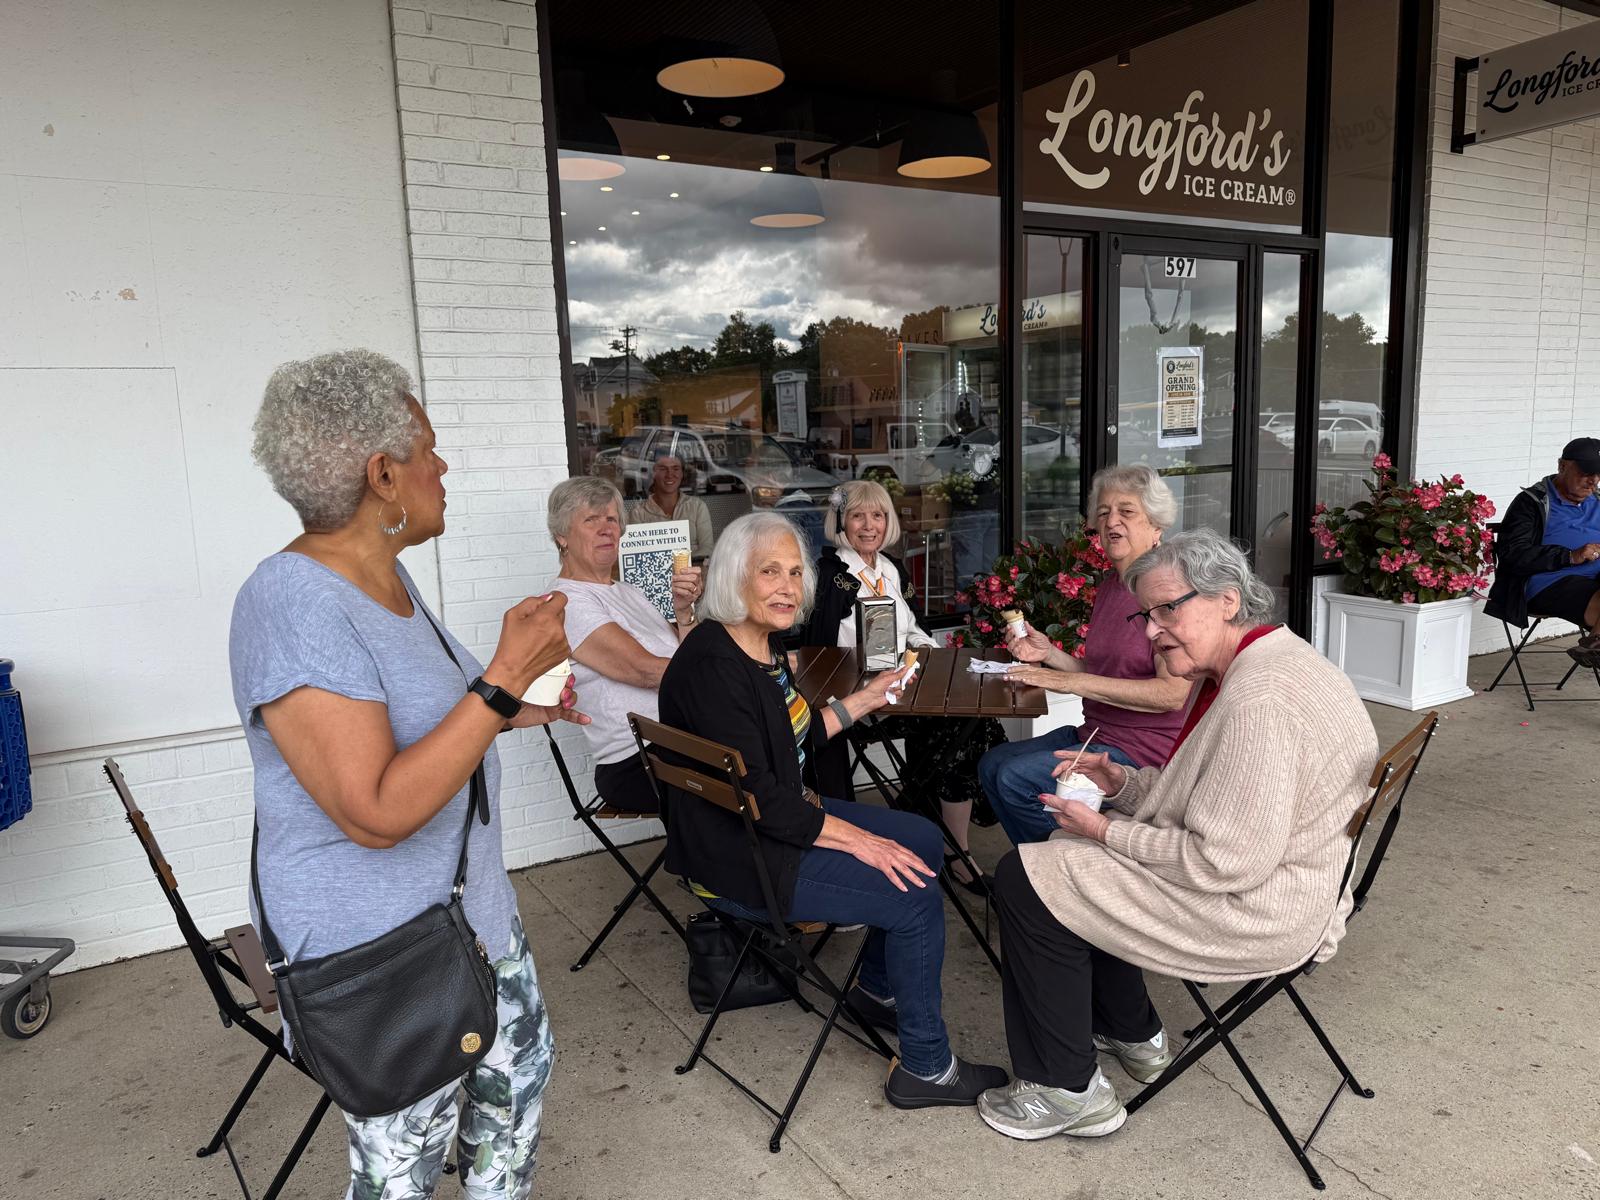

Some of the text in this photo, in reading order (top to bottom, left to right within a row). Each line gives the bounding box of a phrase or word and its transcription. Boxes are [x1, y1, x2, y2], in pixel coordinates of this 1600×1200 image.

[1562, 83, 1584, 97] ICE
[1039, 69, 1291, 196] Longford's
[1183, 174, 1215, 198] ICE
[1166, 257, 1195, 277] 597
[621, 540, 655, 548] CONNECT
[656, 537, 676, 545] WITH
